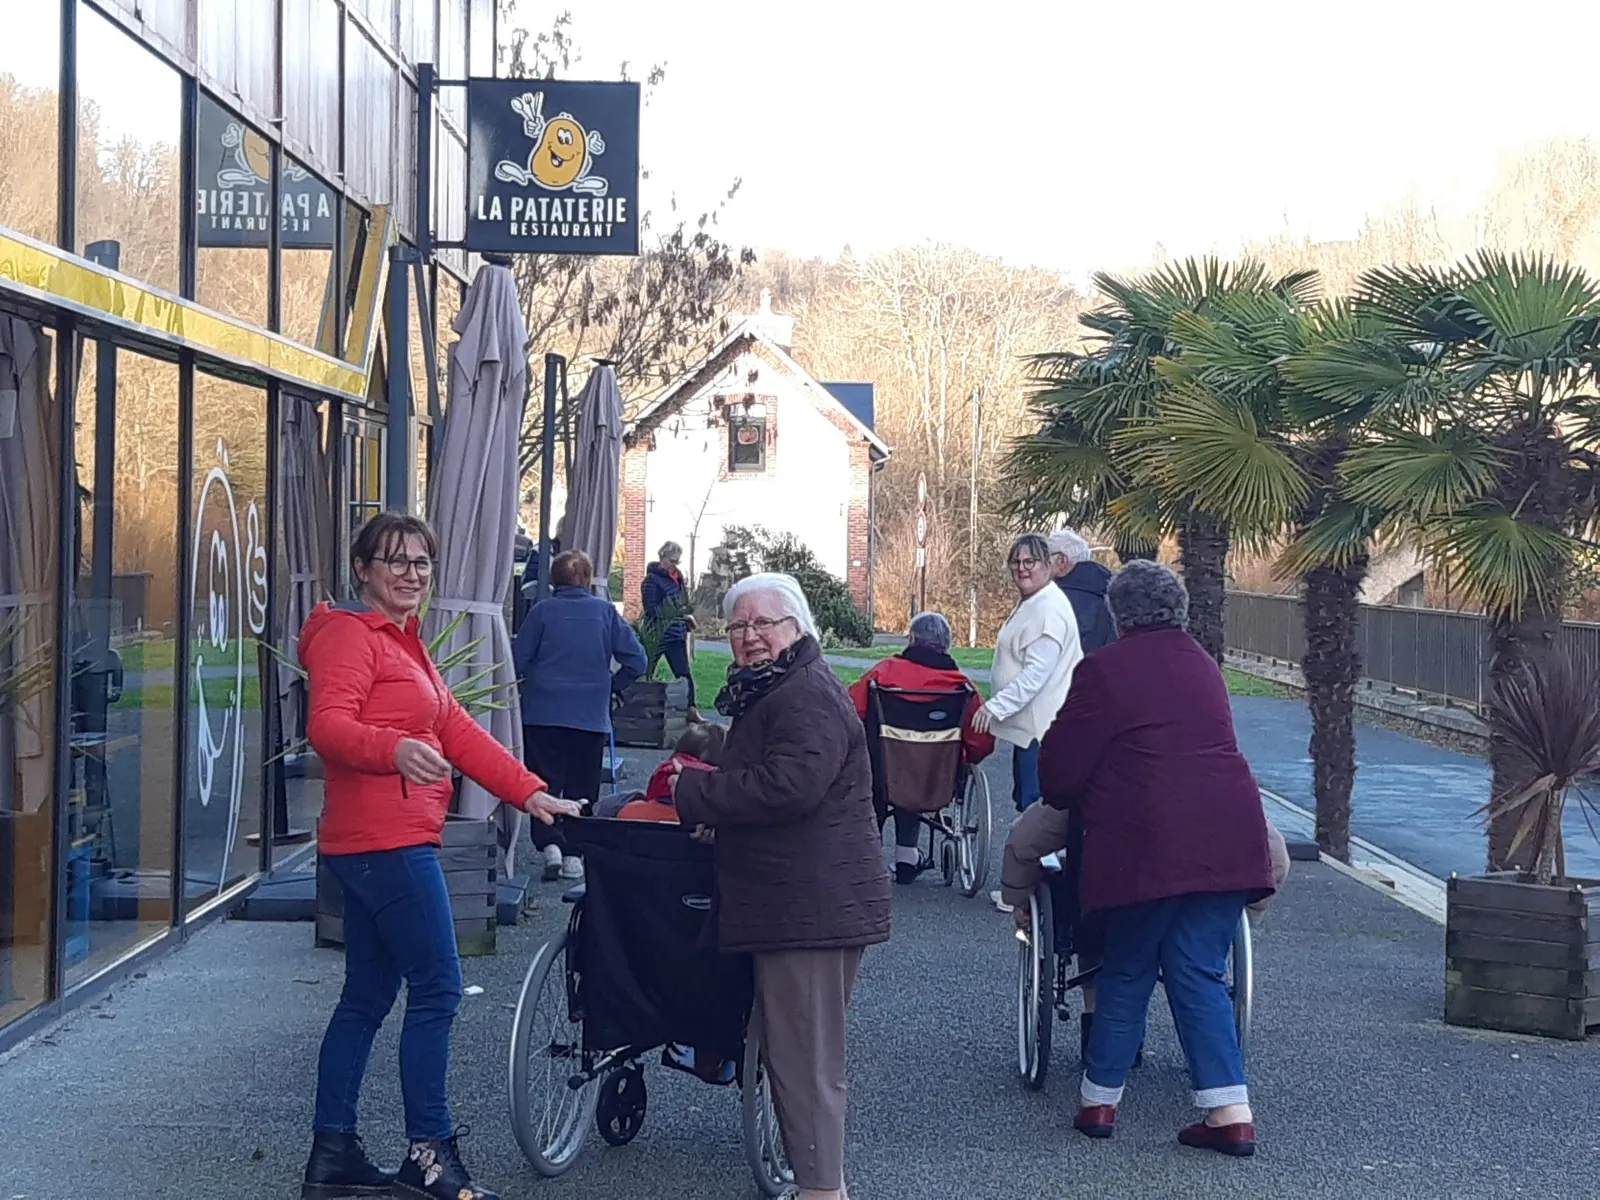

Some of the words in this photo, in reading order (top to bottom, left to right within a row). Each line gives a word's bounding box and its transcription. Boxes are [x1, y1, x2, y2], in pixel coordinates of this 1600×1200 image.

[477, 195, 503, 221] LA
[510, 196, 627, 223] PATATERIE
[510, 222, 613, 237] RESTAURANT
